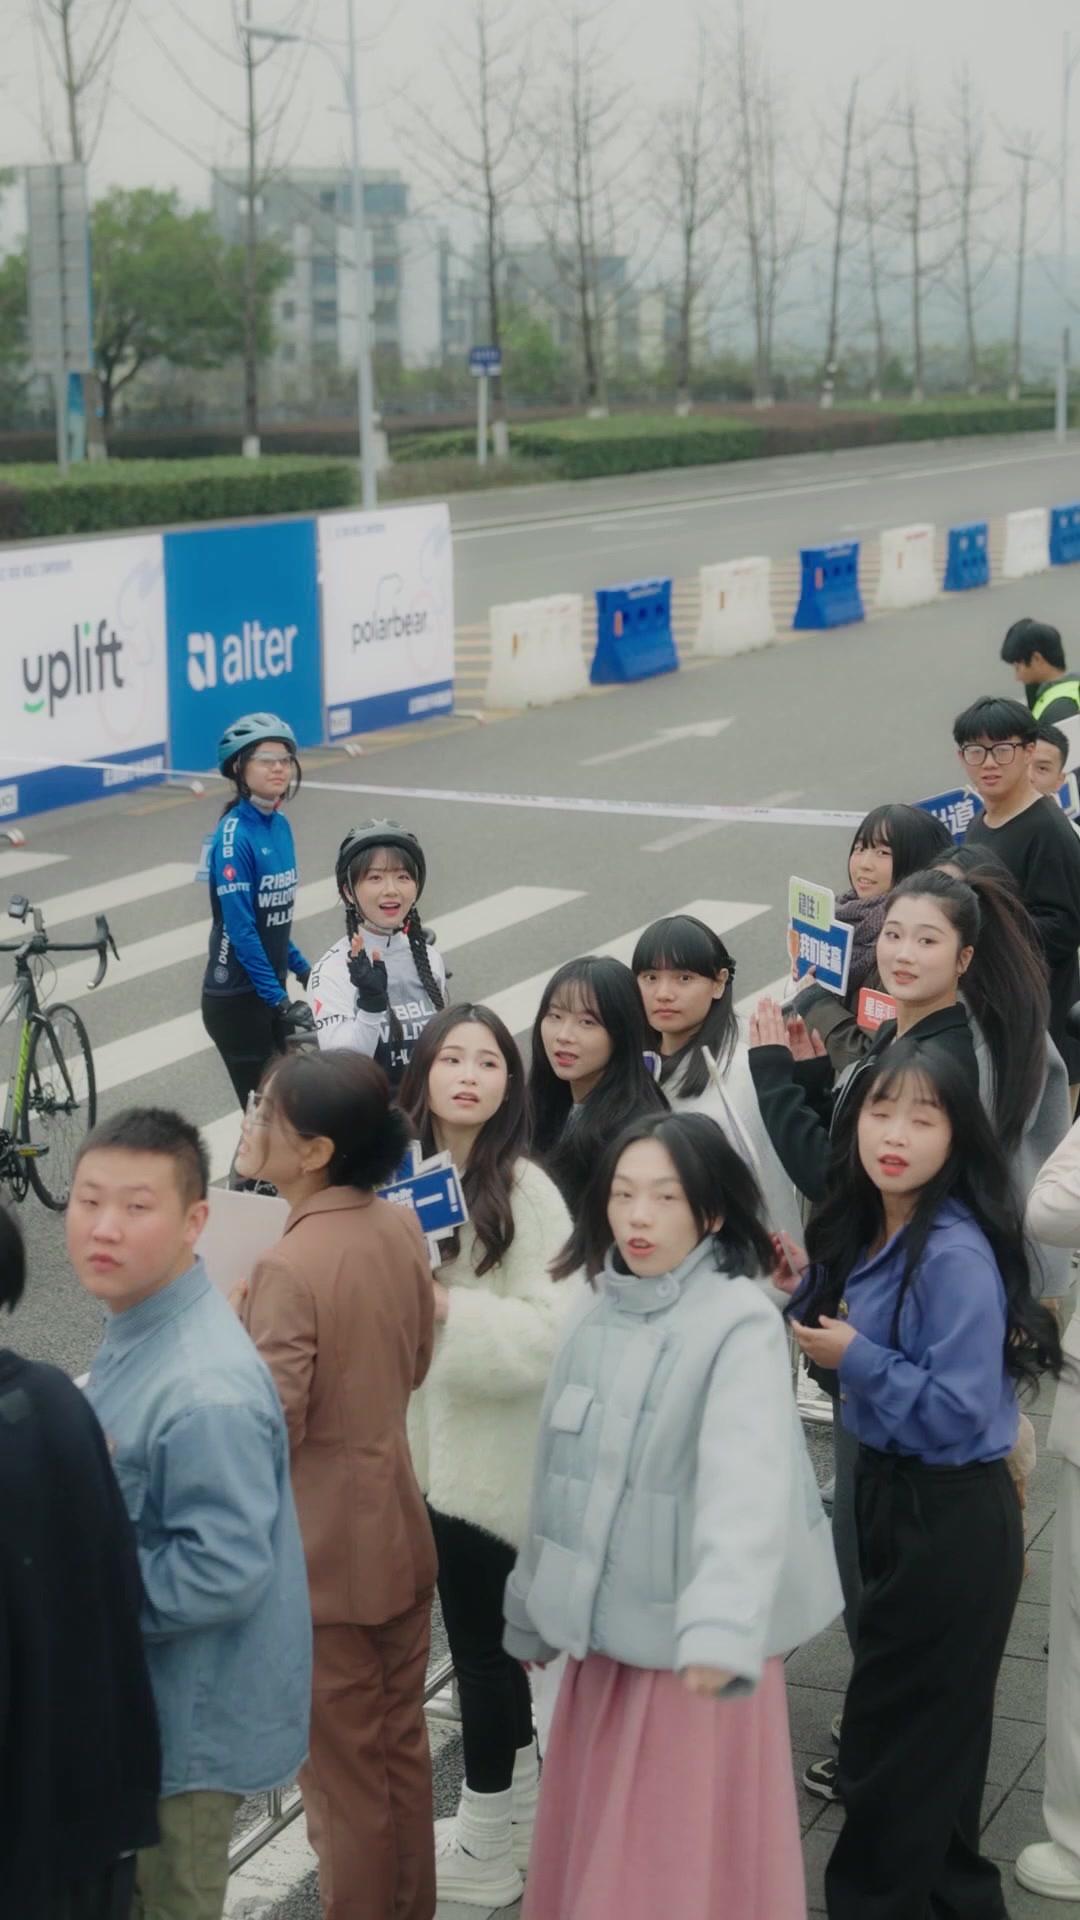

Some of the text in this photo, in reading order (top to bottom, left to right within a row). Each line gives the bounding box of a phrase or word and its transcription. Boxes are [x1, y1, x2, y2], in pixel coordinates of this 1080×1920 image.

[222, 619, 298, 685] alter
[351, 606, 427, 655] polarbear
[23, 618, 125, 719] uplift
